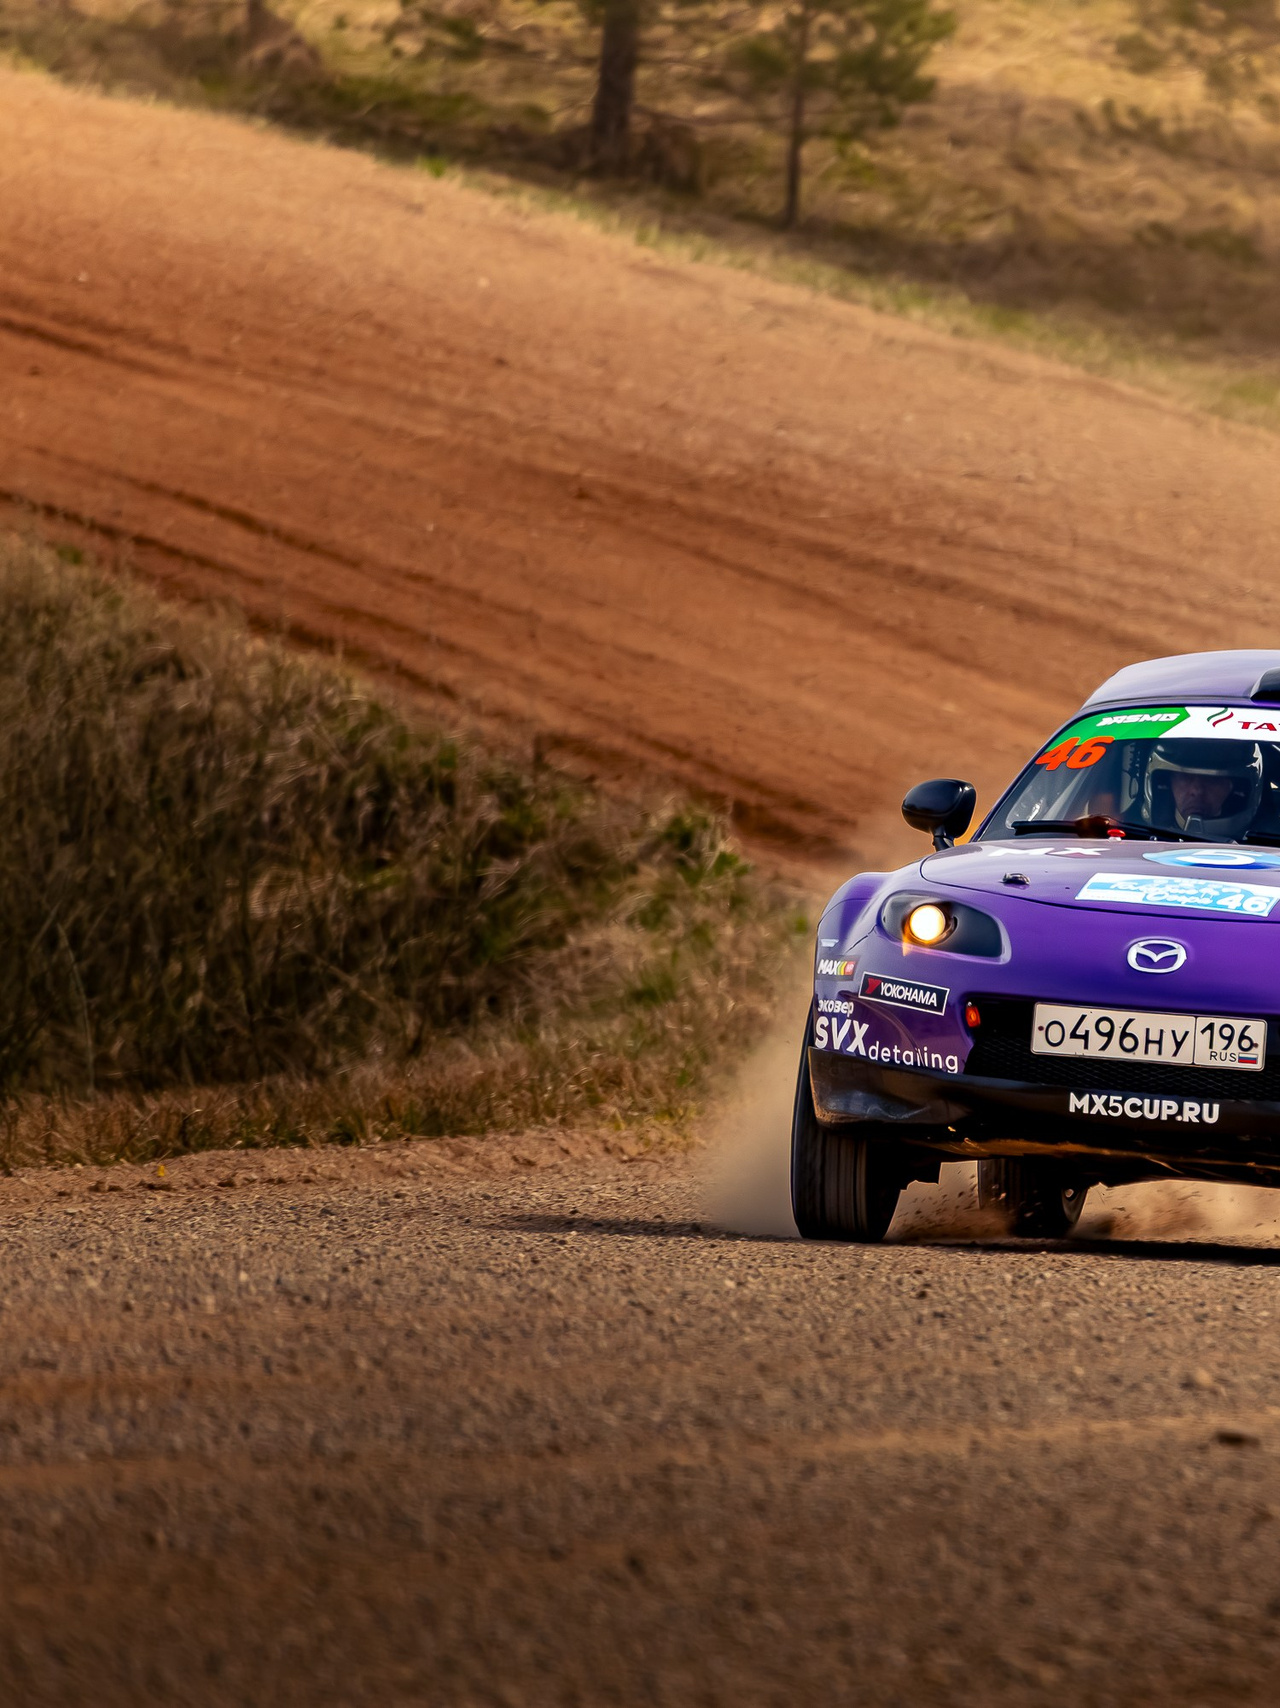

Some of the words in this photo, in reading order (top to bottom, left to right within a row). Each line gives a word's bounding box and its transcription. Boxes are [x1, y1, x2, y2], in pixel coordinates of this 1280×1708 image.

[1035, 736, 1115, 771] 46
[1216, 893, 1271, 914] 46
[817, 959, 841, 976] MAX
[880, 981, 938, 1008] YOKOHAMA
[815, 1016, 869, 1056] SVX
[868, 1041, 958, 1074] detailing
[1200, 1022, 1255, 1052] 196
[1209, 1051, 1238, 1063] RUS
[1068, 1091, 1221, 1124] MX5CUP.RU
